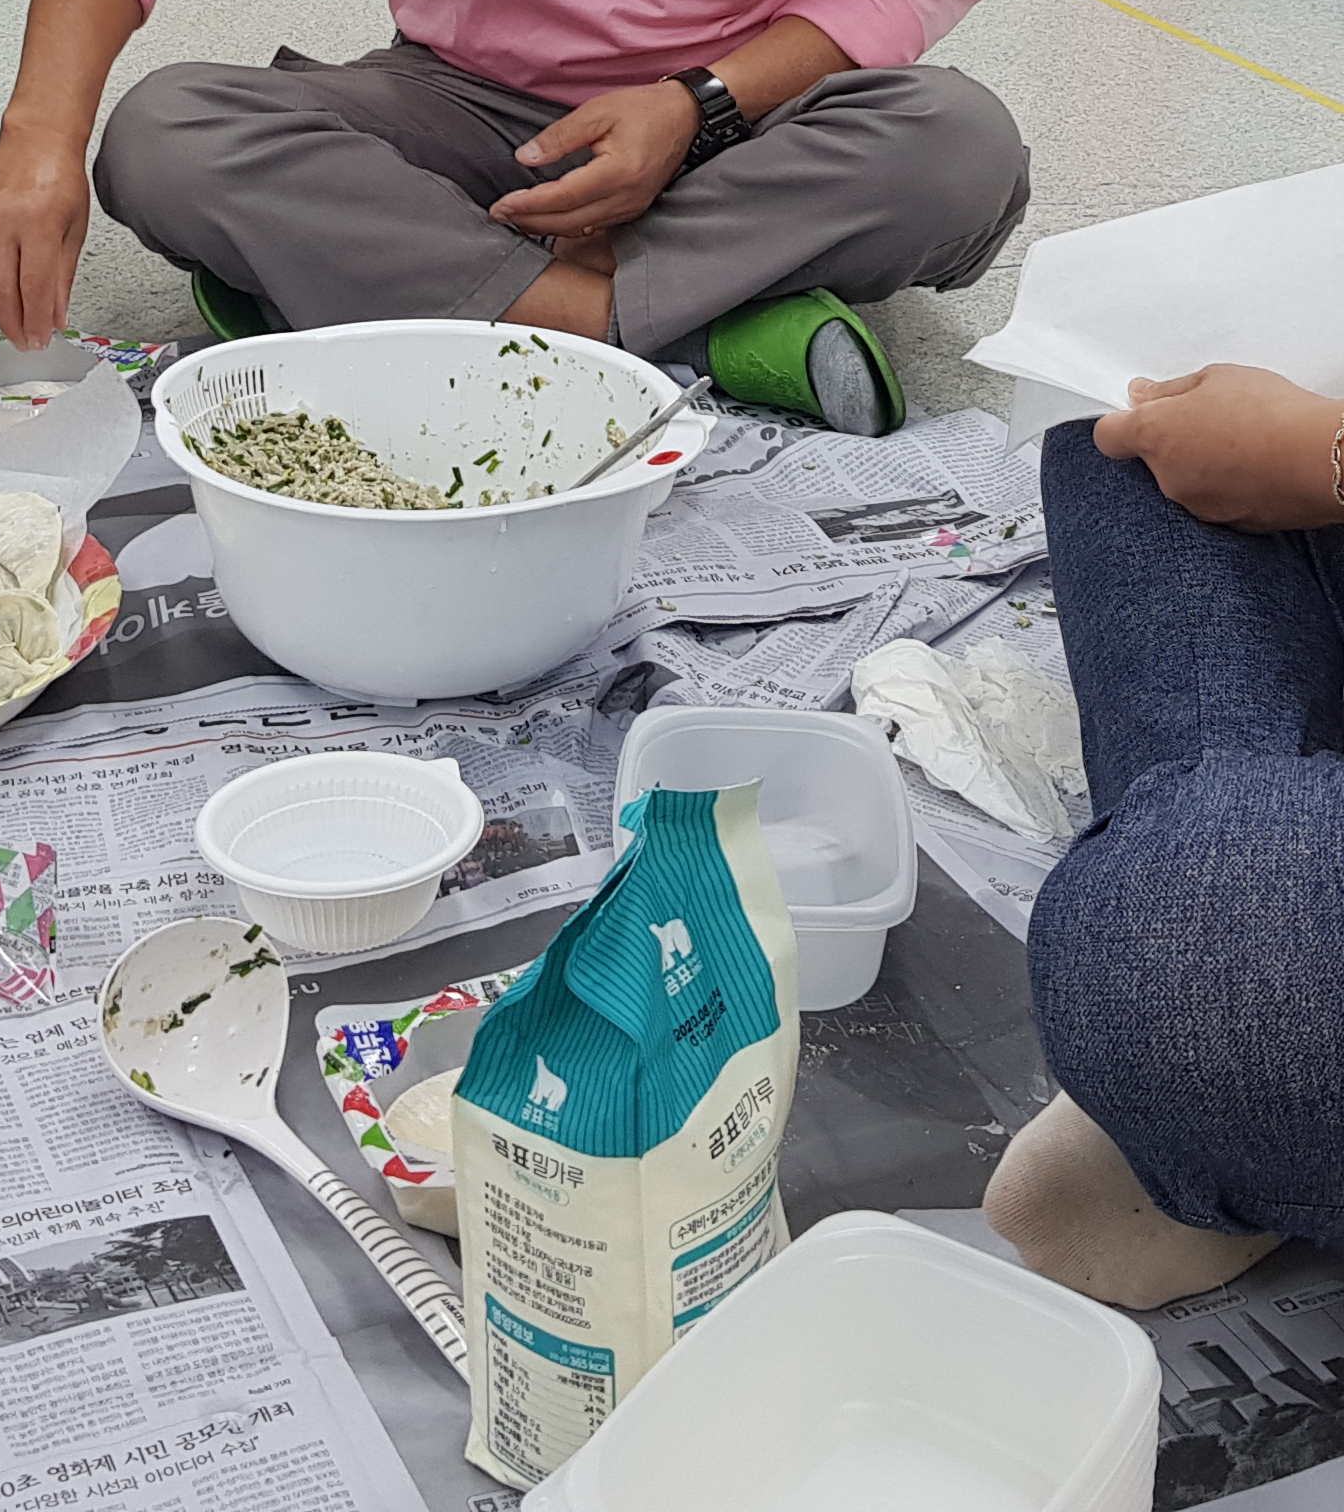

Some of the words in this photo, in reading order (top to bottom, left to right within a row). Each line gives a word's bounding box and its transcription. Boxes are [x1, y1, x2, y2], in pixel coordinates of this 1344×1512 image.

[98, 588, 228, 656] 울케어
[92, 761, 158, 779] 업무협약
[75, 782, 104, 792] 상호
[109, 776, 138, 790] 연계
[118, 878, 151, 895] 구축
[157, 872, 189, 888] 사업
[194, 871, 225, 886] 선정
[93, 897, 138, 911] 서비스
[143, 893, 174, 905] 대폭
[664, 962, 694, 997] 곰표
[25, 1023, 65, 1045] 업체
[0, 1047, 51, 1066] 것으로
[707, 1076, 775, 1160] 곰표밀가루
[491, 1132, 586, 1190] 곰표밀가루
[151, 1177, 194, 1195] 조성
[47, 1218, 82, 1235] 함께
[87, 1211, 123, 1228] 계속
[47, 1448, 118, 1483] 영화제
[124, 1438, 172, 1468] 시민
[174, 1419, 246, 1453] 공모전
[248, 1400, 296, 1428] 개최
[86, 1476, 139, 1499] 시선과
[144, 1451, 215, 1484] 아이디어
